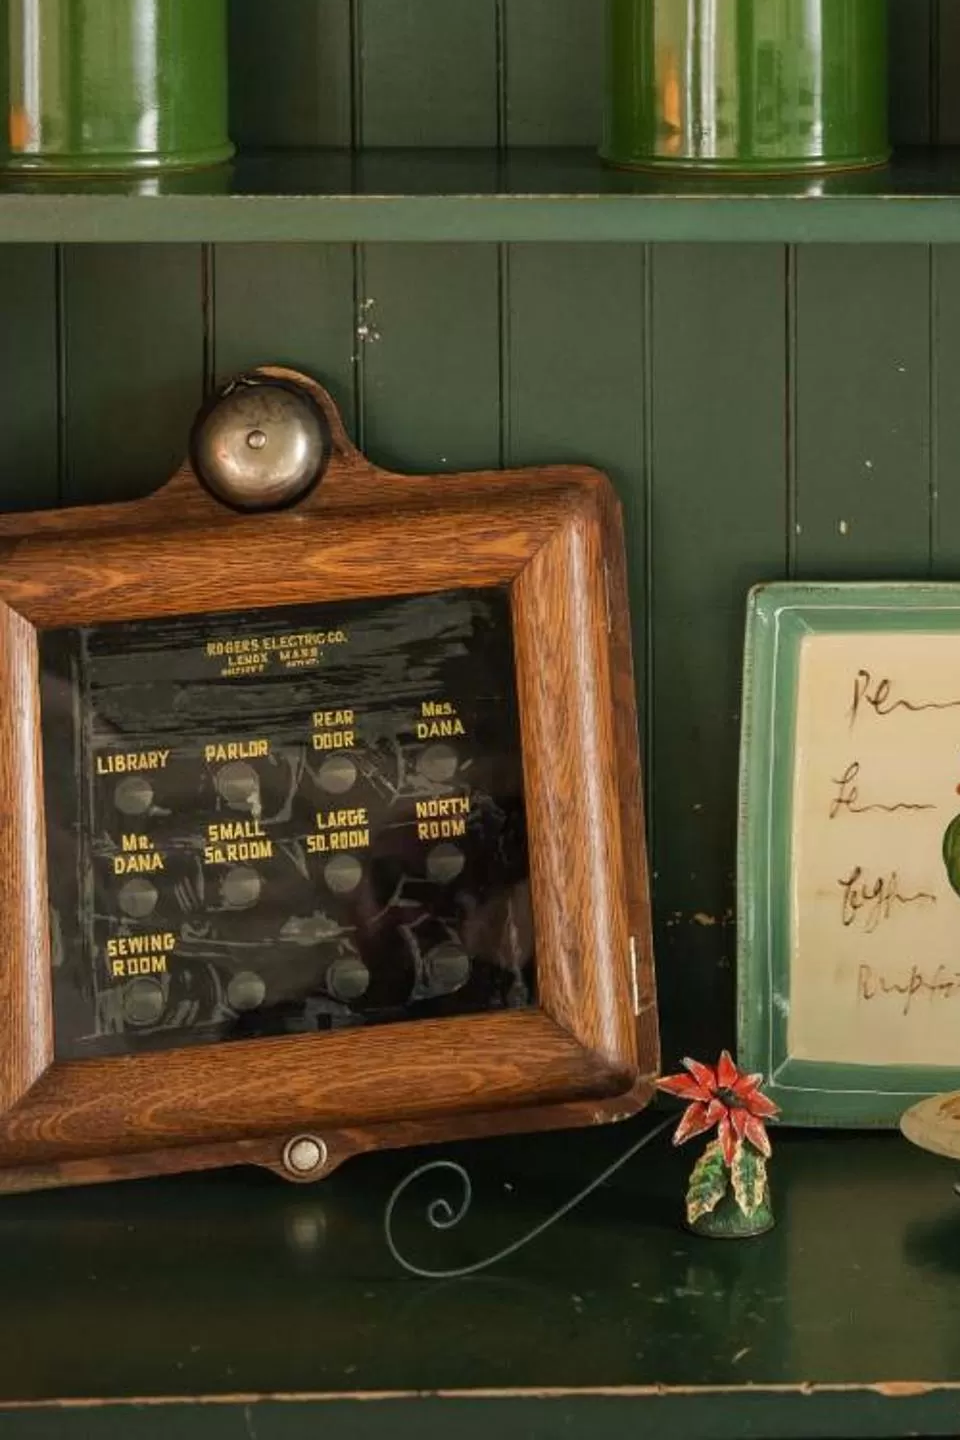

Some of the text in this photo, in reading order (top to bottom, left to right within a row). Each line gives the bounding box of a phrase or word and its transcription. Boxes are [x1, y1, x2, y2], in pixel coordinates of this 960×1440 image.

[206, 639, 260, 656] ROGERS
[262, 633, 326, 650] ELECTRIC
[313, 710, 355, 728] REAR
[417, 718, 466, 739] DANA
[205, 740, 269, 762] PARLOR
[312, 731, 355, 750] DOOR
[97, 750, 170, 775] LIBRARY
[416, 797, 470, 818] NORTH
[316, 808, 369, 830] LARGE
[418, 819, 466, 840] ROOM
[208, 820, 266, 842] SMALL
[330, 829, 370, 850] ROOM
[227, 840, 273, 862] ROOM
[114, 852, 165, 875] DANA
[107, 934, 175, 957] SEWING
[113, 956, 167, 977] ROOM
